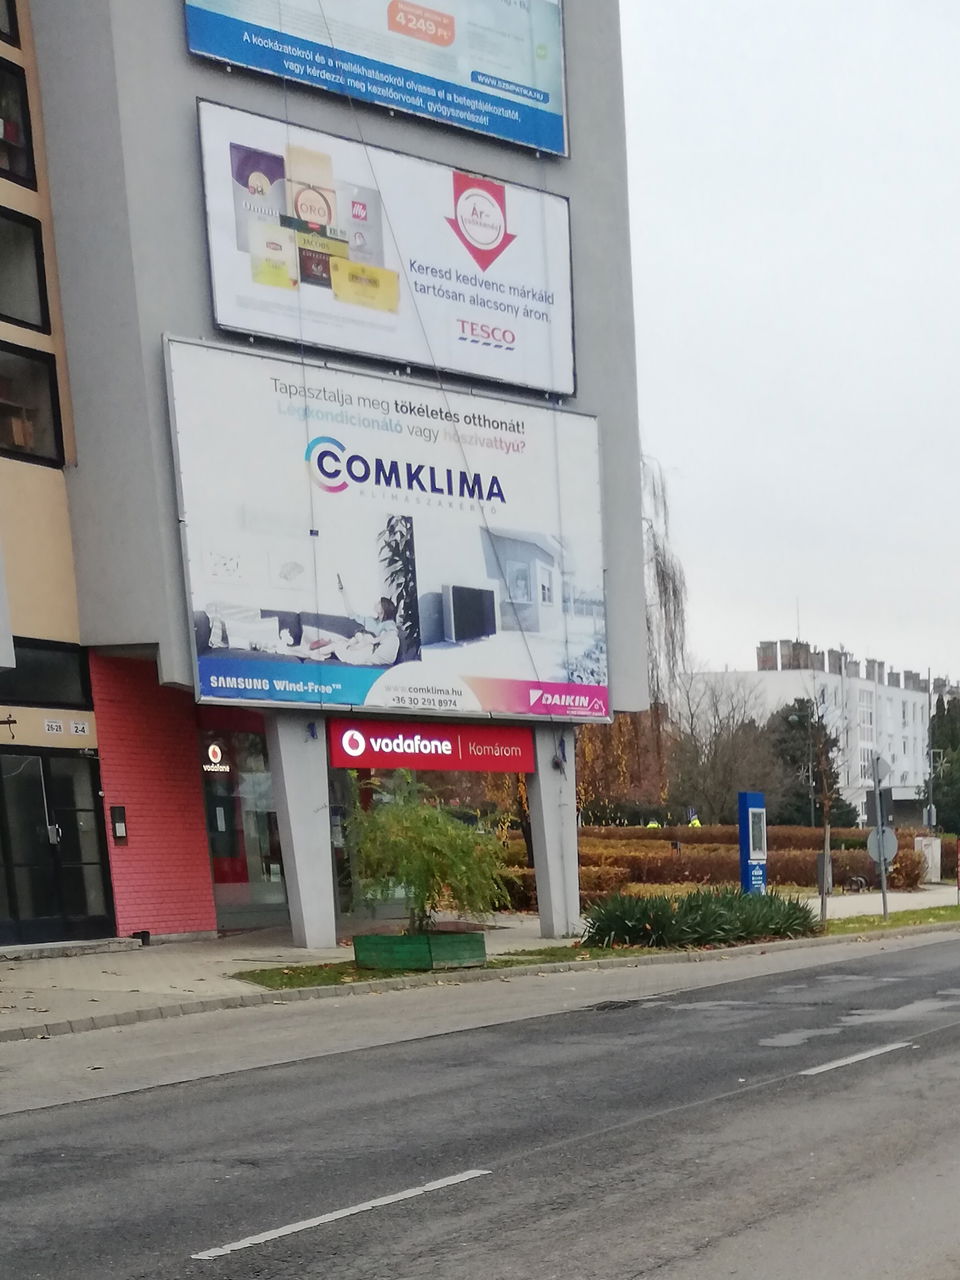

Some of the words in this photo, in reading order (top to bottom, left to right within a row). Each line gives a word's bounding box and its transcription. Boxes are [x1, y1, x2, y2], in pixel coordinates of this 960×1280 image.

[242, 32, 251, 43] A
[252, 33, 313, 61] kockázatokról
[315, 52, 326, 65] és
[327, 58, 334, 66] a
[335, 61, 404, 88] mellékhatásokról
[406, 80, 436, 97] olvassa
[437, 89, 445, 99] el
[446, 94, 453, 102] a
[283, 60, 305, 75] vagy
[306, 64, 345, 85] kérdezze
[347, 78, 366, 92] meg
[299, 202, 327, 218] ORO
[352, 203, 368, 219] illy
[409, 259, 452, 281] Keresd
[455, 269, 506, 294] kedvenc
[508, 286, 555, 305] márkáid
[414, 280, 466, 303] tartósan
[469, 294, 520, 318] alacsony
[456, 318, 517, 345] TESCO
[269, 377, 353, 407] Tapasztalja
[357, 394, 390, 416] meg
[393, 399, 460, 424] tökéletes
[463, 411, 526, 435] otthonát!
[407, 424, 440, 444] vagy
[316, 449, 507, 504] COMKLIMA
[209, 675, 270, 691] SAMSUNG
[392, 695, 406, 705] +36
[408, 696, 419, 706] 30
[421, 697, 436, 707] 291
[438, 698, 457, 707] 8974
[541, 693, 589, 707] DAIKIN
[370, 734, 452, 755] vodafone
[468, 741, 522, 757] Komárom
[202, 763, 230, 773] vodafone
